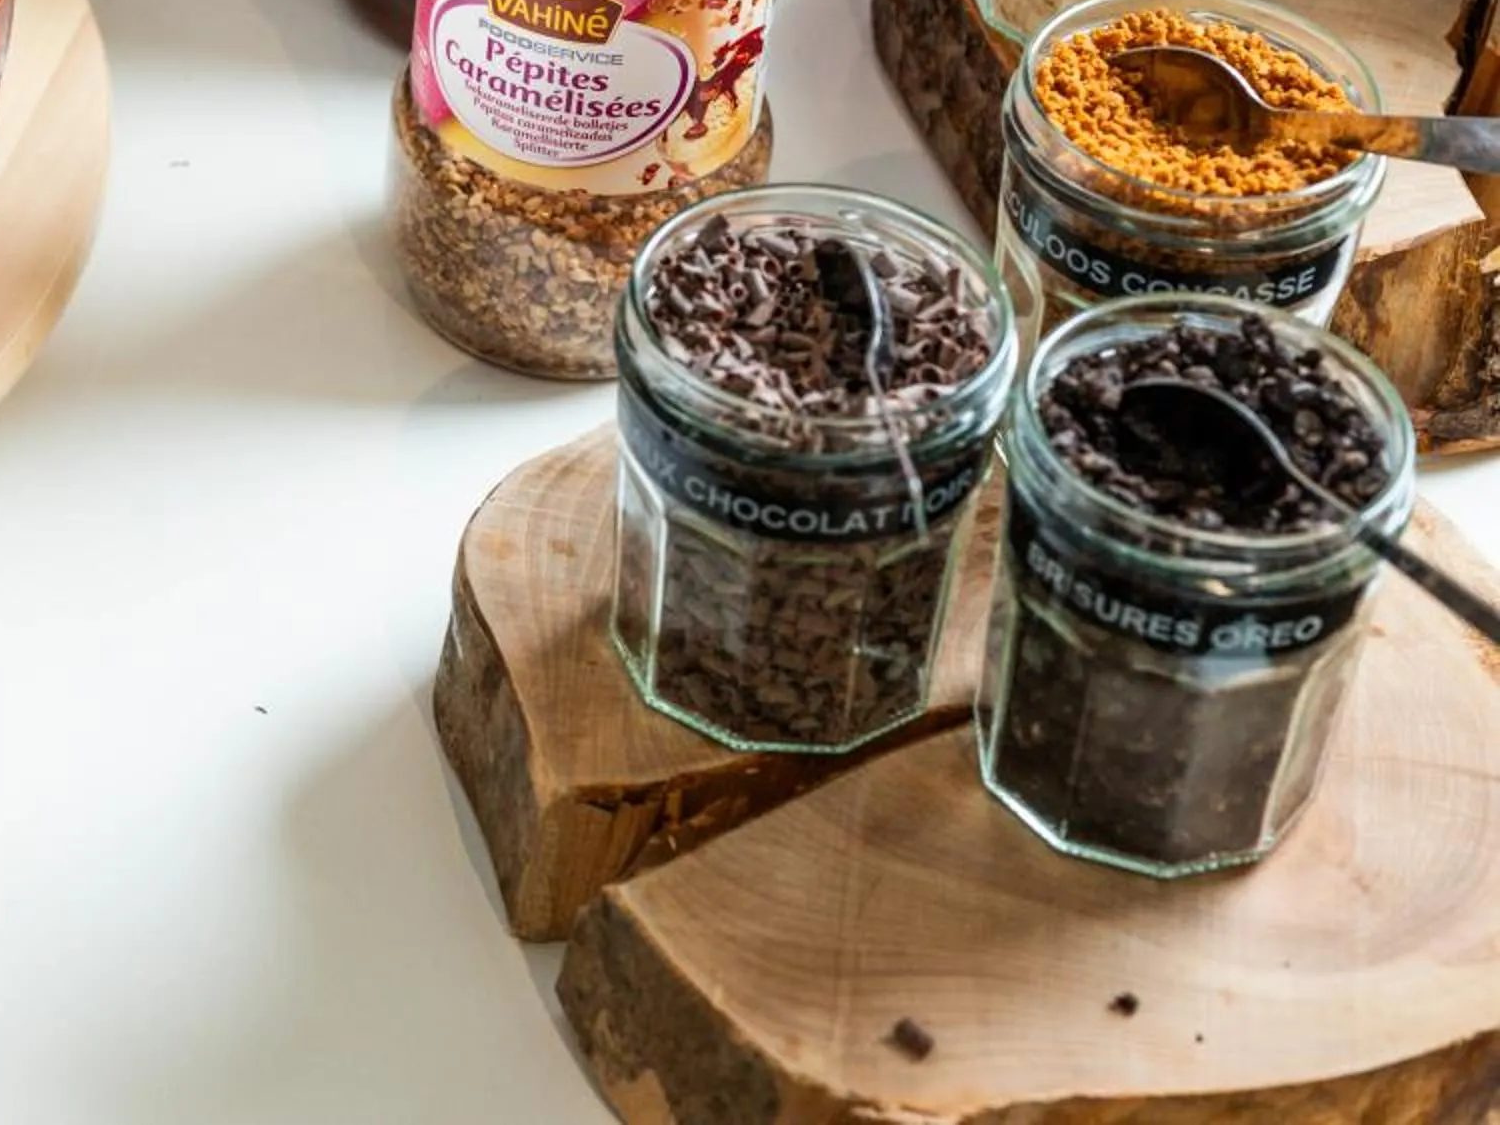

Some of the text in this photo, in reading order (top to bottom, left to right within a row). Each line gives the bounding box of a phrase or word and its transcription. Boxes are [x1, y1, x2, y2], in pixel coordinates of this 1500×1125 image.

[477, 16, 625, 66] FOODSERVICE
[485, 35, 610, 93] Pépites
[444, 38, 662, 119] Caramélisées
[1004, 187, 1112, 285] CULOOS
[683, 474, 895, 536] CHOCOLAT
[1026, 539, 1325, 651] BRISURES OREO
